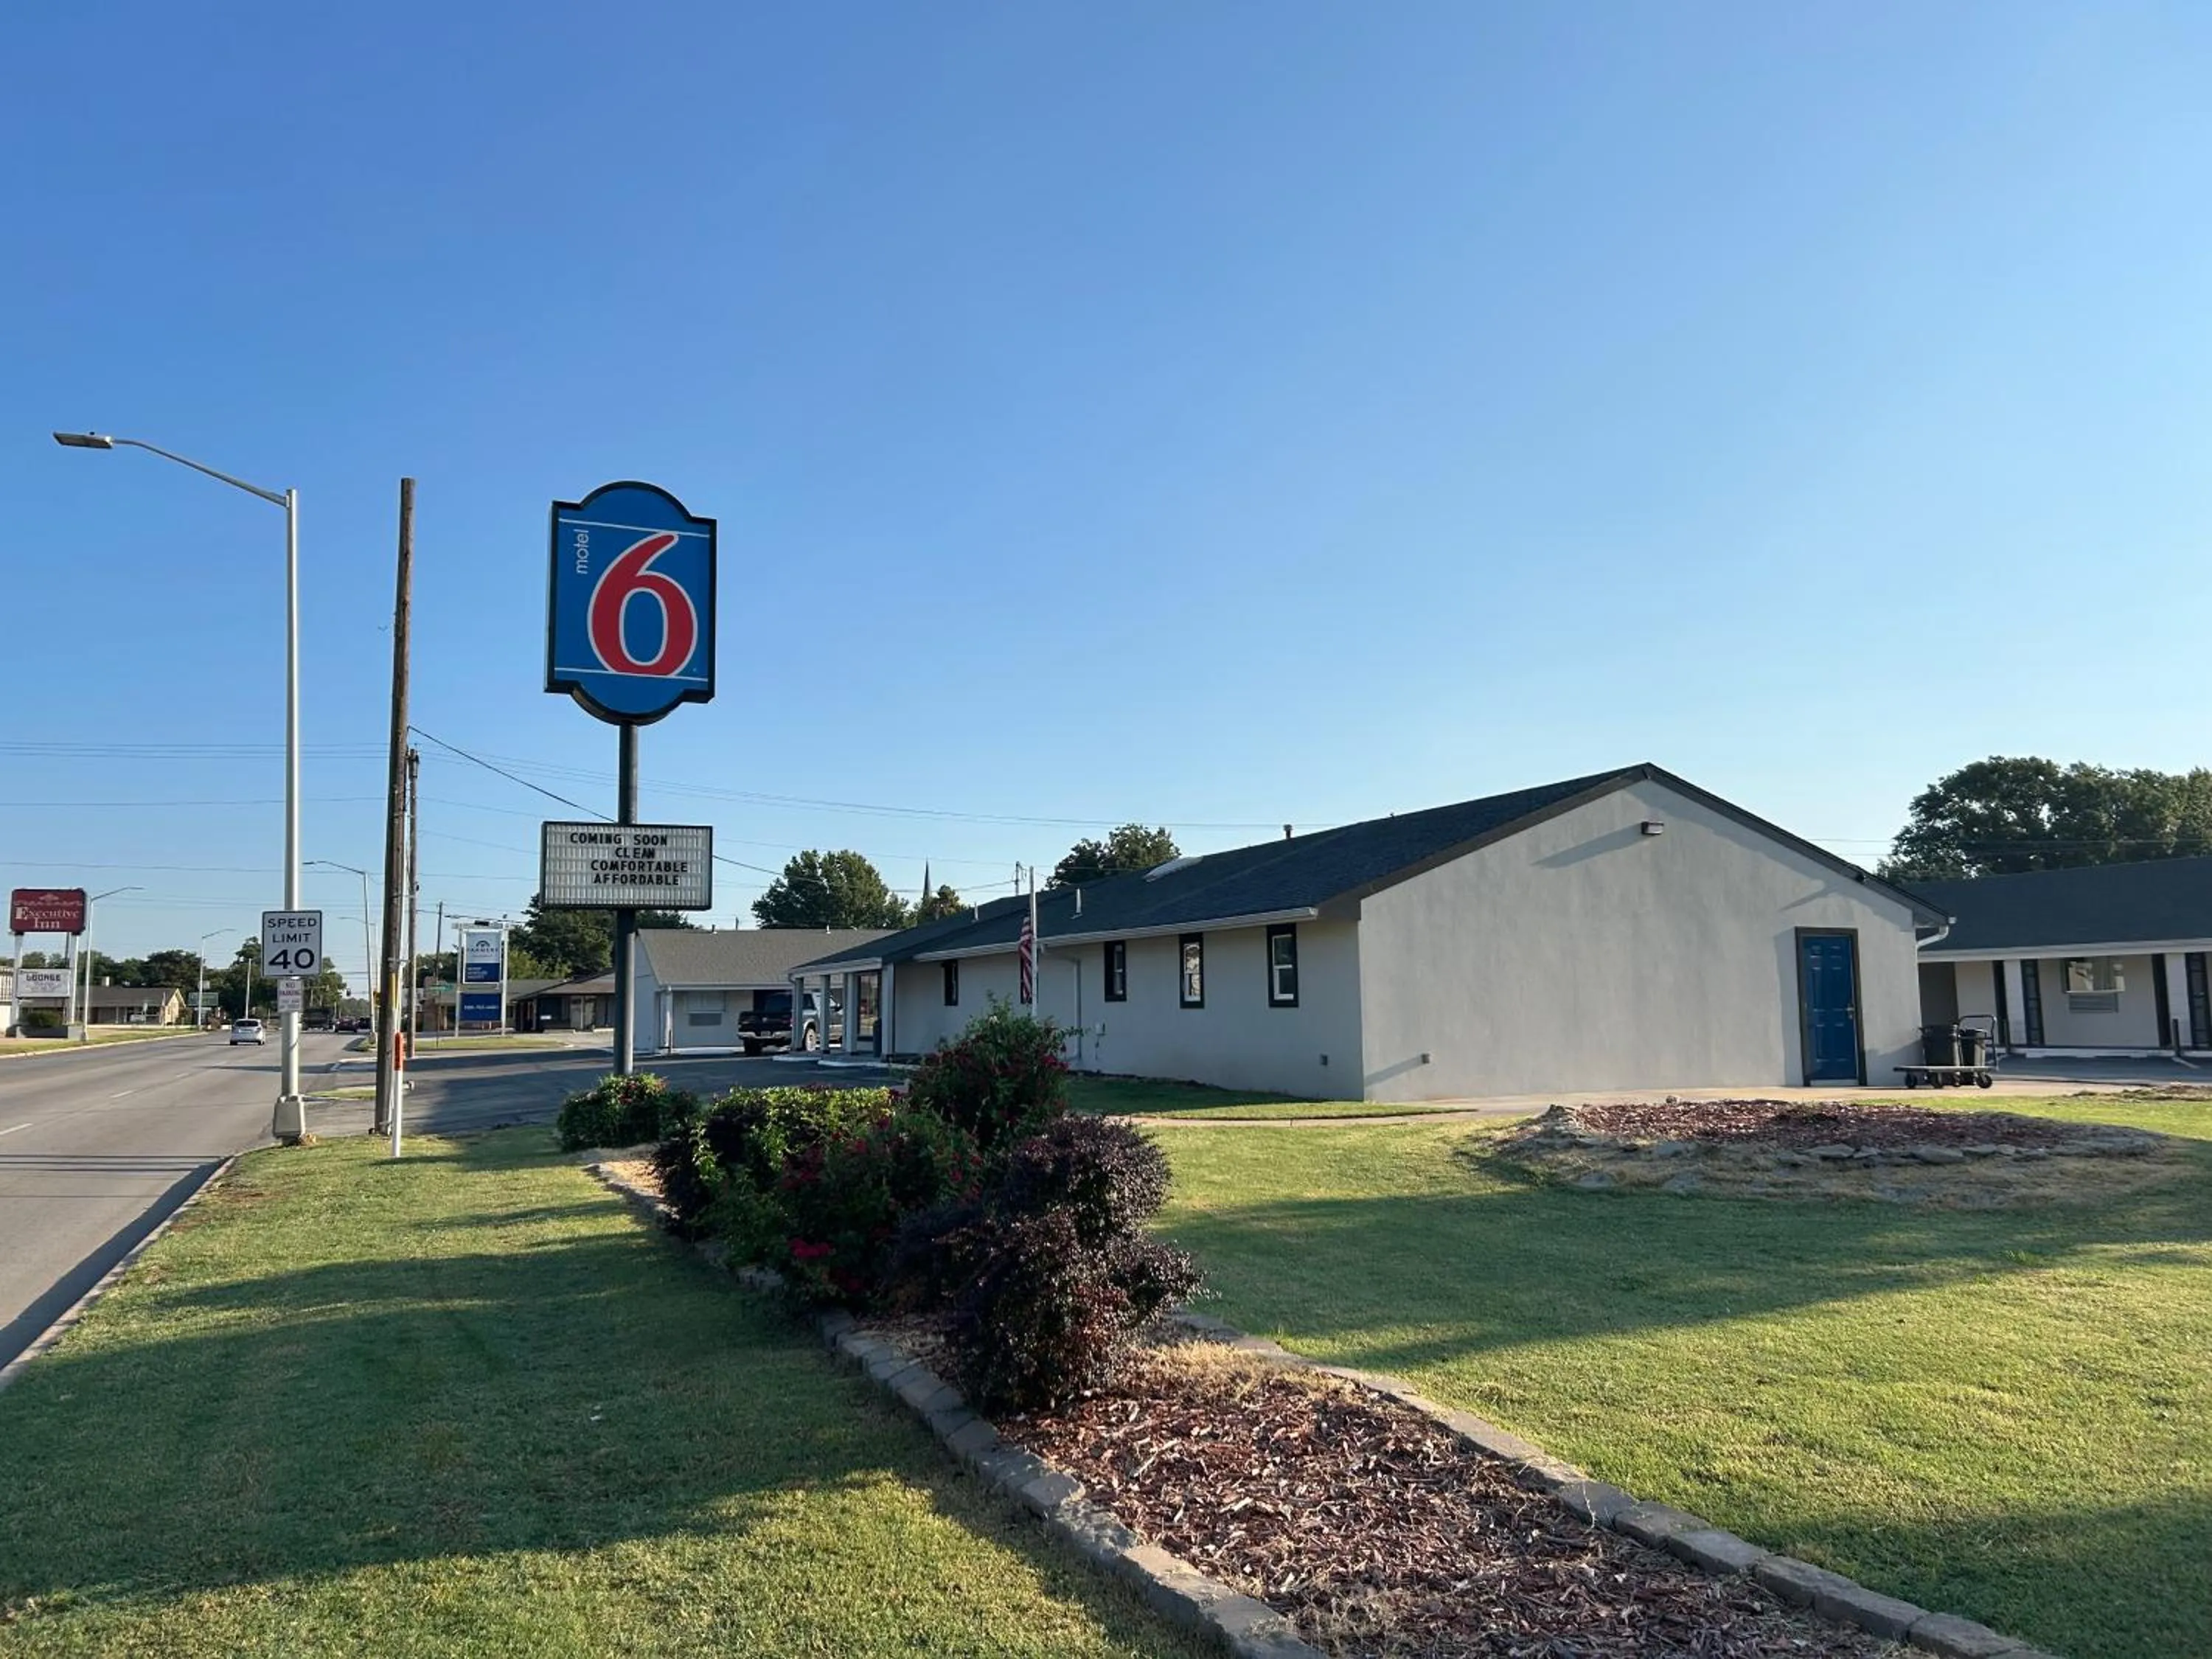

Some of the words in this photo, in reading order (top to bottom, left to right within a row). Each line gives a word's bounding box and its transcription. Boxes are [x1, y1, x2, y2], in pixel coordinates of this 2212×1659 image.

[574, 529, 589, 574] motel
[587, 531, 698, 677] 6
[570, 832, 622, 845] COMING
[633, 834, 667, 846] SOON
[615, 848, 655, 859] CLEAN
[591, 860, 688, 872] COMFORTABLE
[594, 873, 679, 886] AFFORDABLE
[268, 918, 317, 928] SPEED
[272, 933, 311, 943] LIMIT
[268, 947, 315, 970] 40
